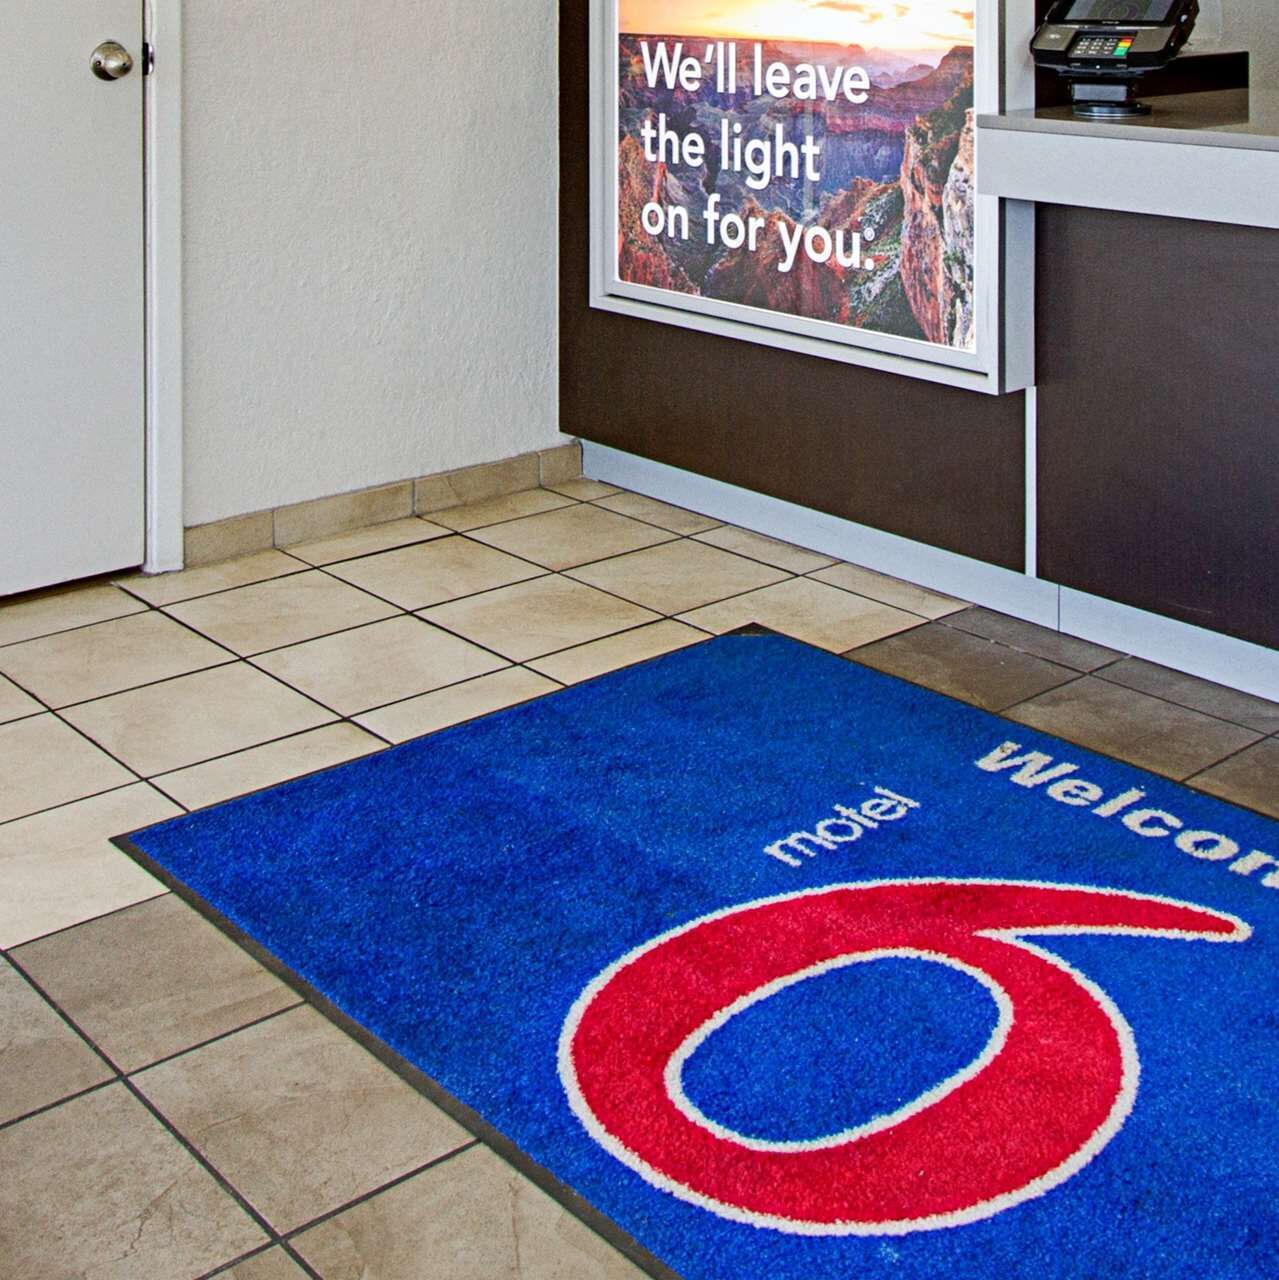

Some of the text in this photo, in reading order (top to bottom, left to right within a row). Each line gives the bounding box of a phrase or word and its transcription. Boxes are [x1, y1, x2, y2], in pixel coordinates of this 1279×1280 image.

[640, 41, 870, 104] We'll leave
[640, 113, 820, 190] the light
[642, 202, 689, 240] on
[703, 193, 765, 251] for
[763, 785, 920, 869] motel
[556, 876, 1253, 1237] 6
